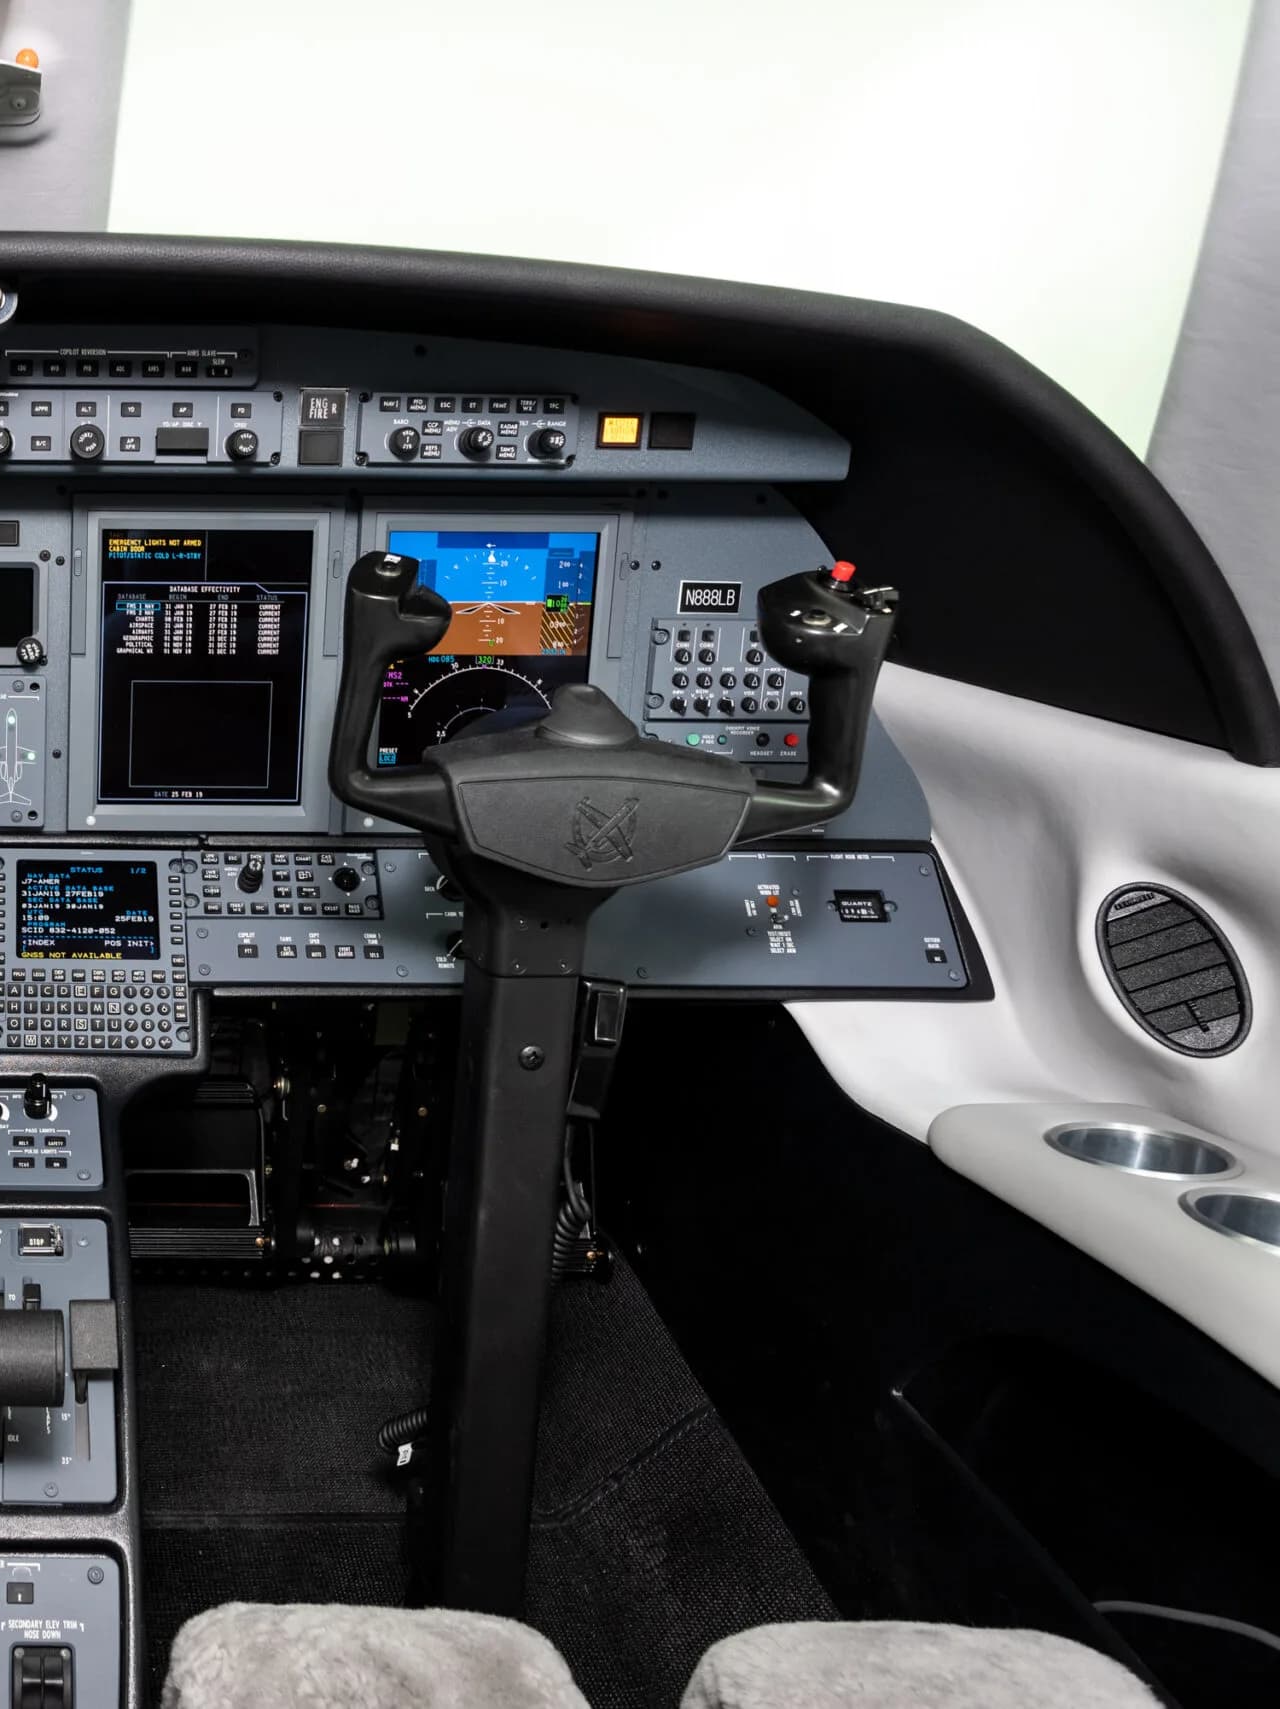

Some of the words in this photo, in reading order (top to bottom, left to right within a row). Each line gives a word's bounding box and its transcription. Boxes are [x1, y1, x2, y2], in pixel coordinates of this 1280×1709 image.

[310, 398, 328, 409] ENG
[309, 408, 328, 420] FIRE
[332, 405, 337, 415] R
[170, 586, 198, 594] DATABASE
[201, 586, 240, 594] EFFECTIVITY
[685, 589, 736, 606] N888LB
[8, 1620, 42, 1629] SECONDARY
[46, 1620, 59, 1629] ELEV
[63, 1620, 77, 1629] TRIM
[24, 1630, 39, 1638] NOSE
[42, 1631, 61, 1639] DOWN
